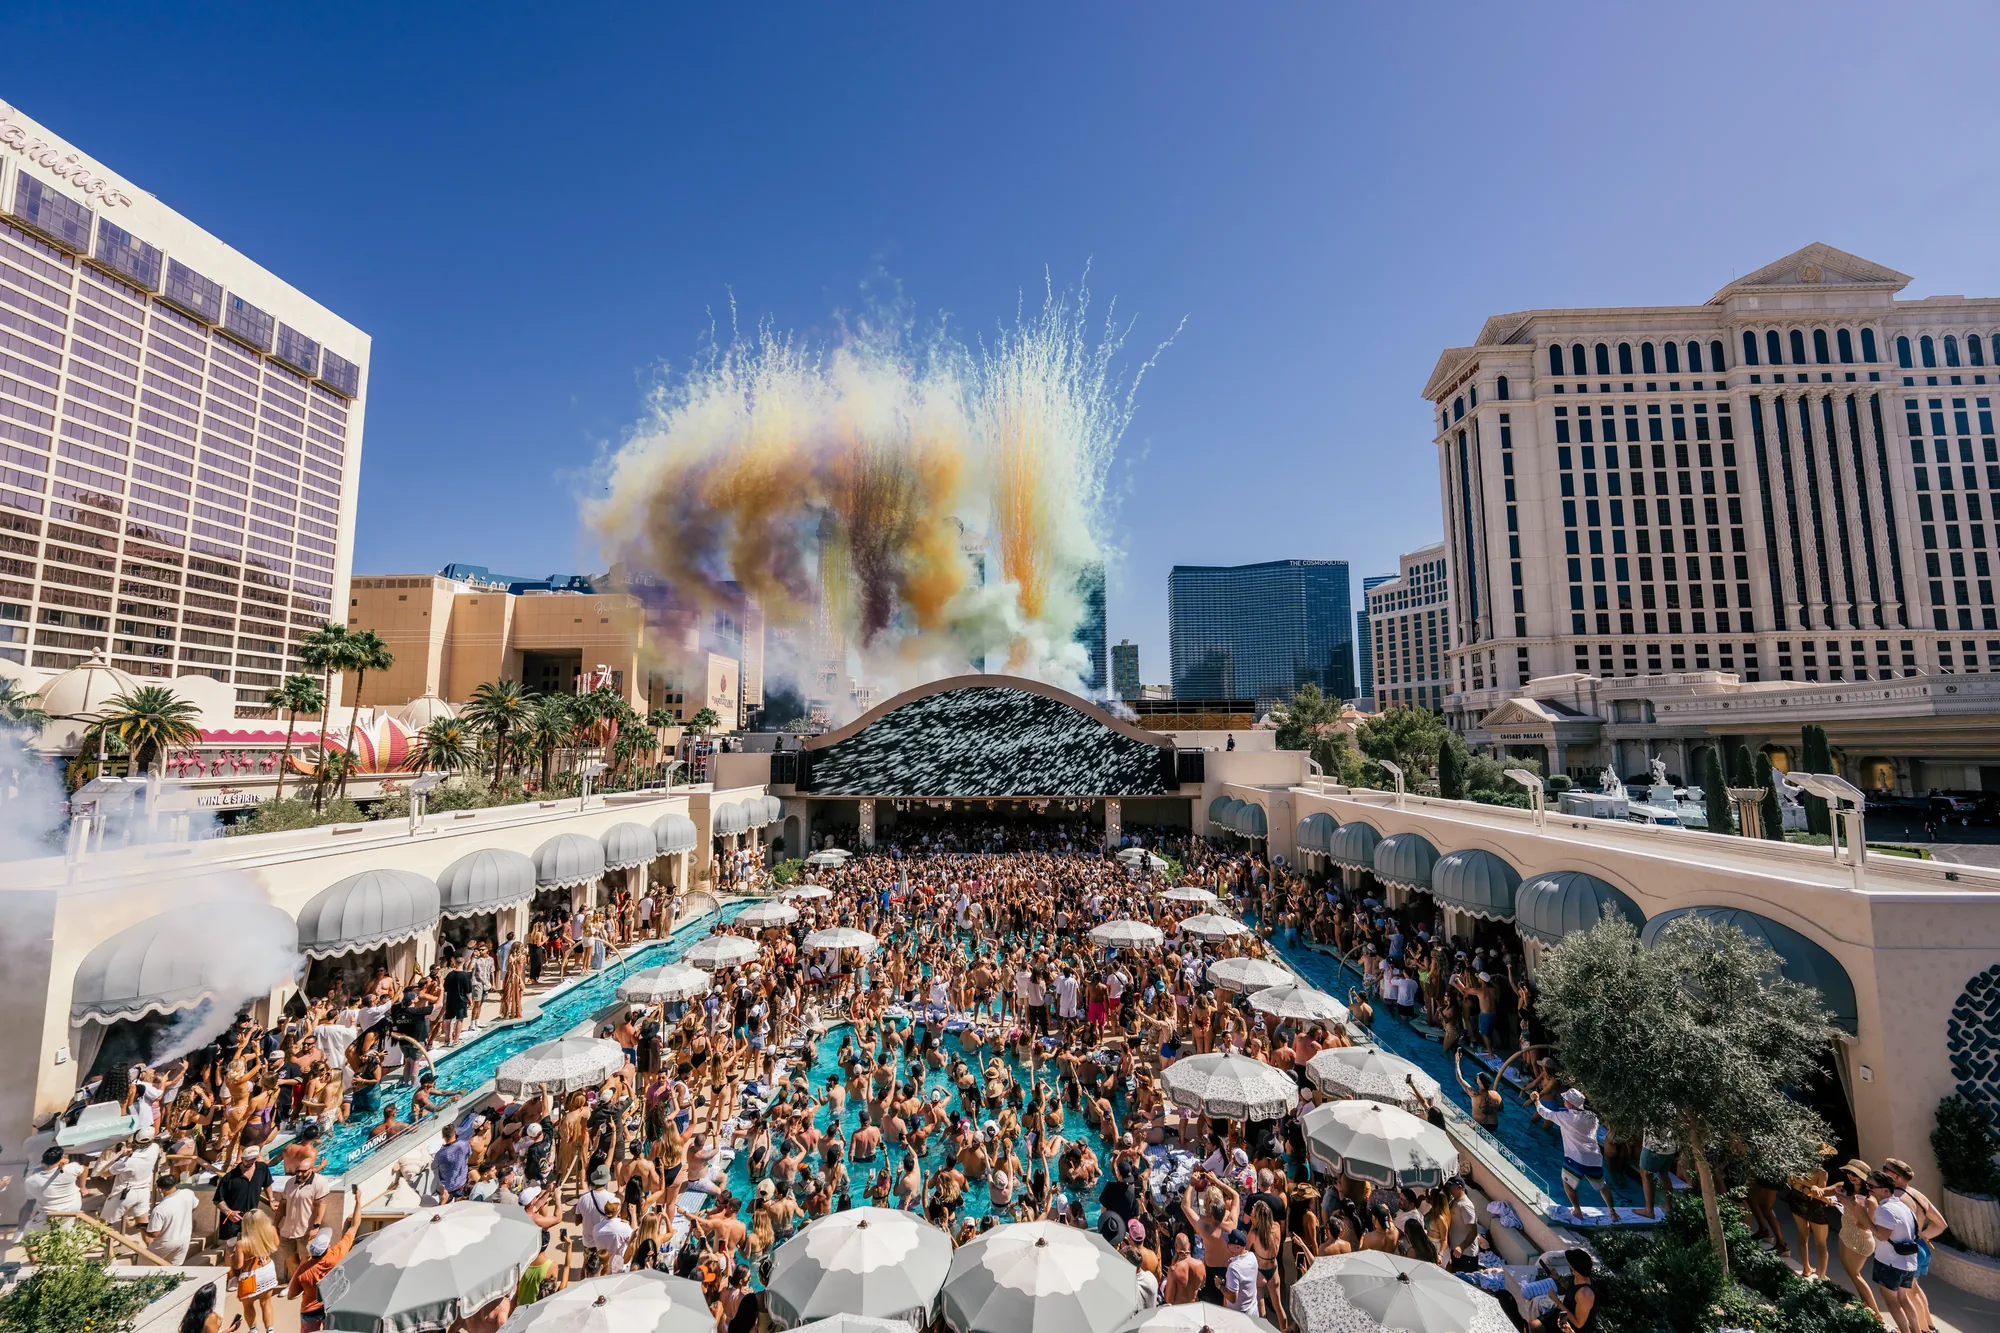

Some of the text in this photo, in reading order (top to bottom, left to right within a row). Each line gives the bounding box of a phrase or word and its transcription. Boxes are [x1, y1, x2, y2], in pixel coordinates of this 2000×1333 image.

[0, 107, 132, 208] amingo
[198, 794, 261, 806] WINE & SPIRITS
[348, 1131, 387, 1162] NO DIVING
